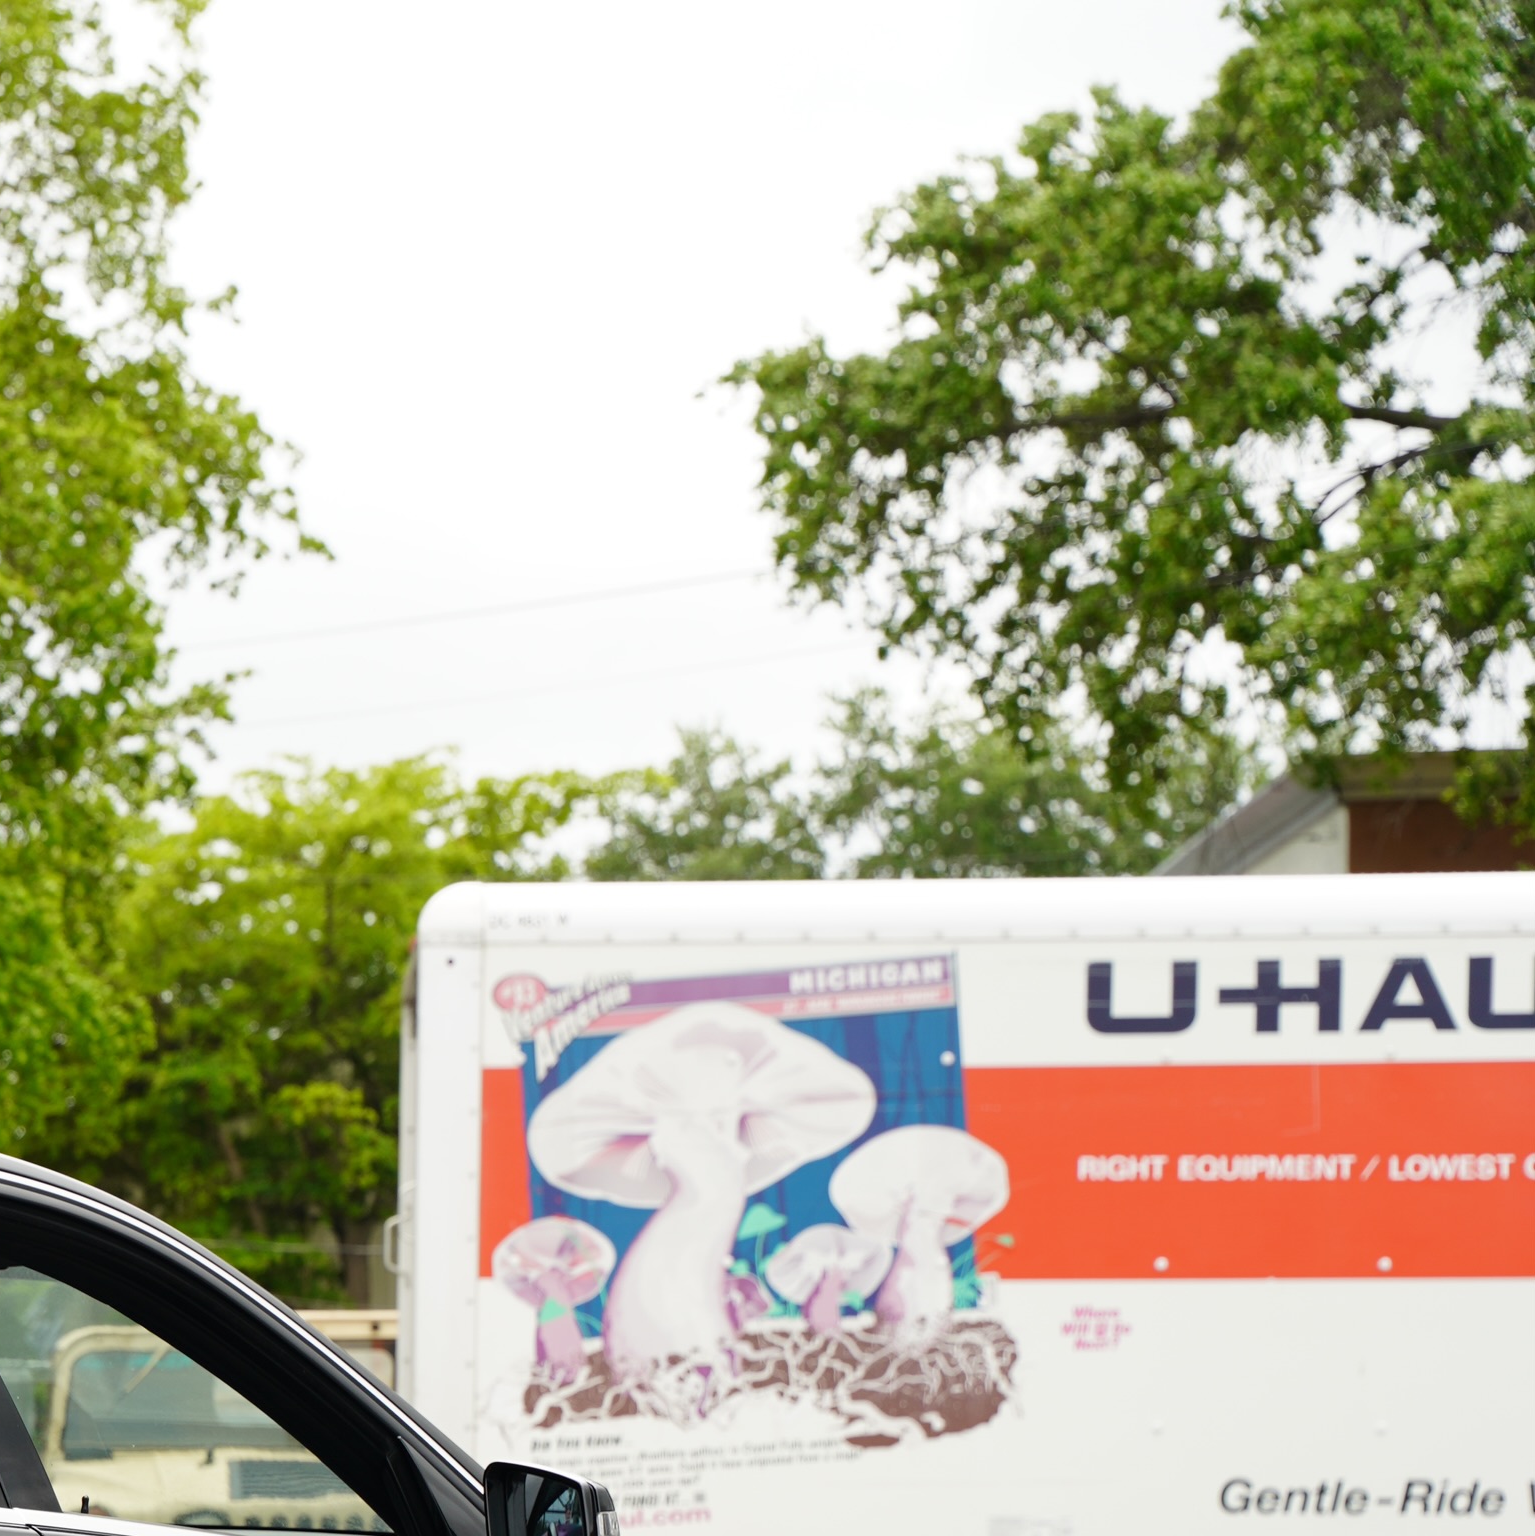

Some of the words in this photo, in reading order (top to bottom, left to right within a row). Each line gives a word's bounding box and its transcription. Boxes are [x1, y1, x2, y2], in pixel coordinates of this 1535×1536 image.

[788, 958, 944, 995] MICHIGAN
[1077, 1154, 1169, 1182] RIGHT
[1177, 1153, 1357, 1182] EQUIPMENT
[1388, 1153, 1517, 1181] LOWEST
[620, 1507, 712, 1530] ul.com
